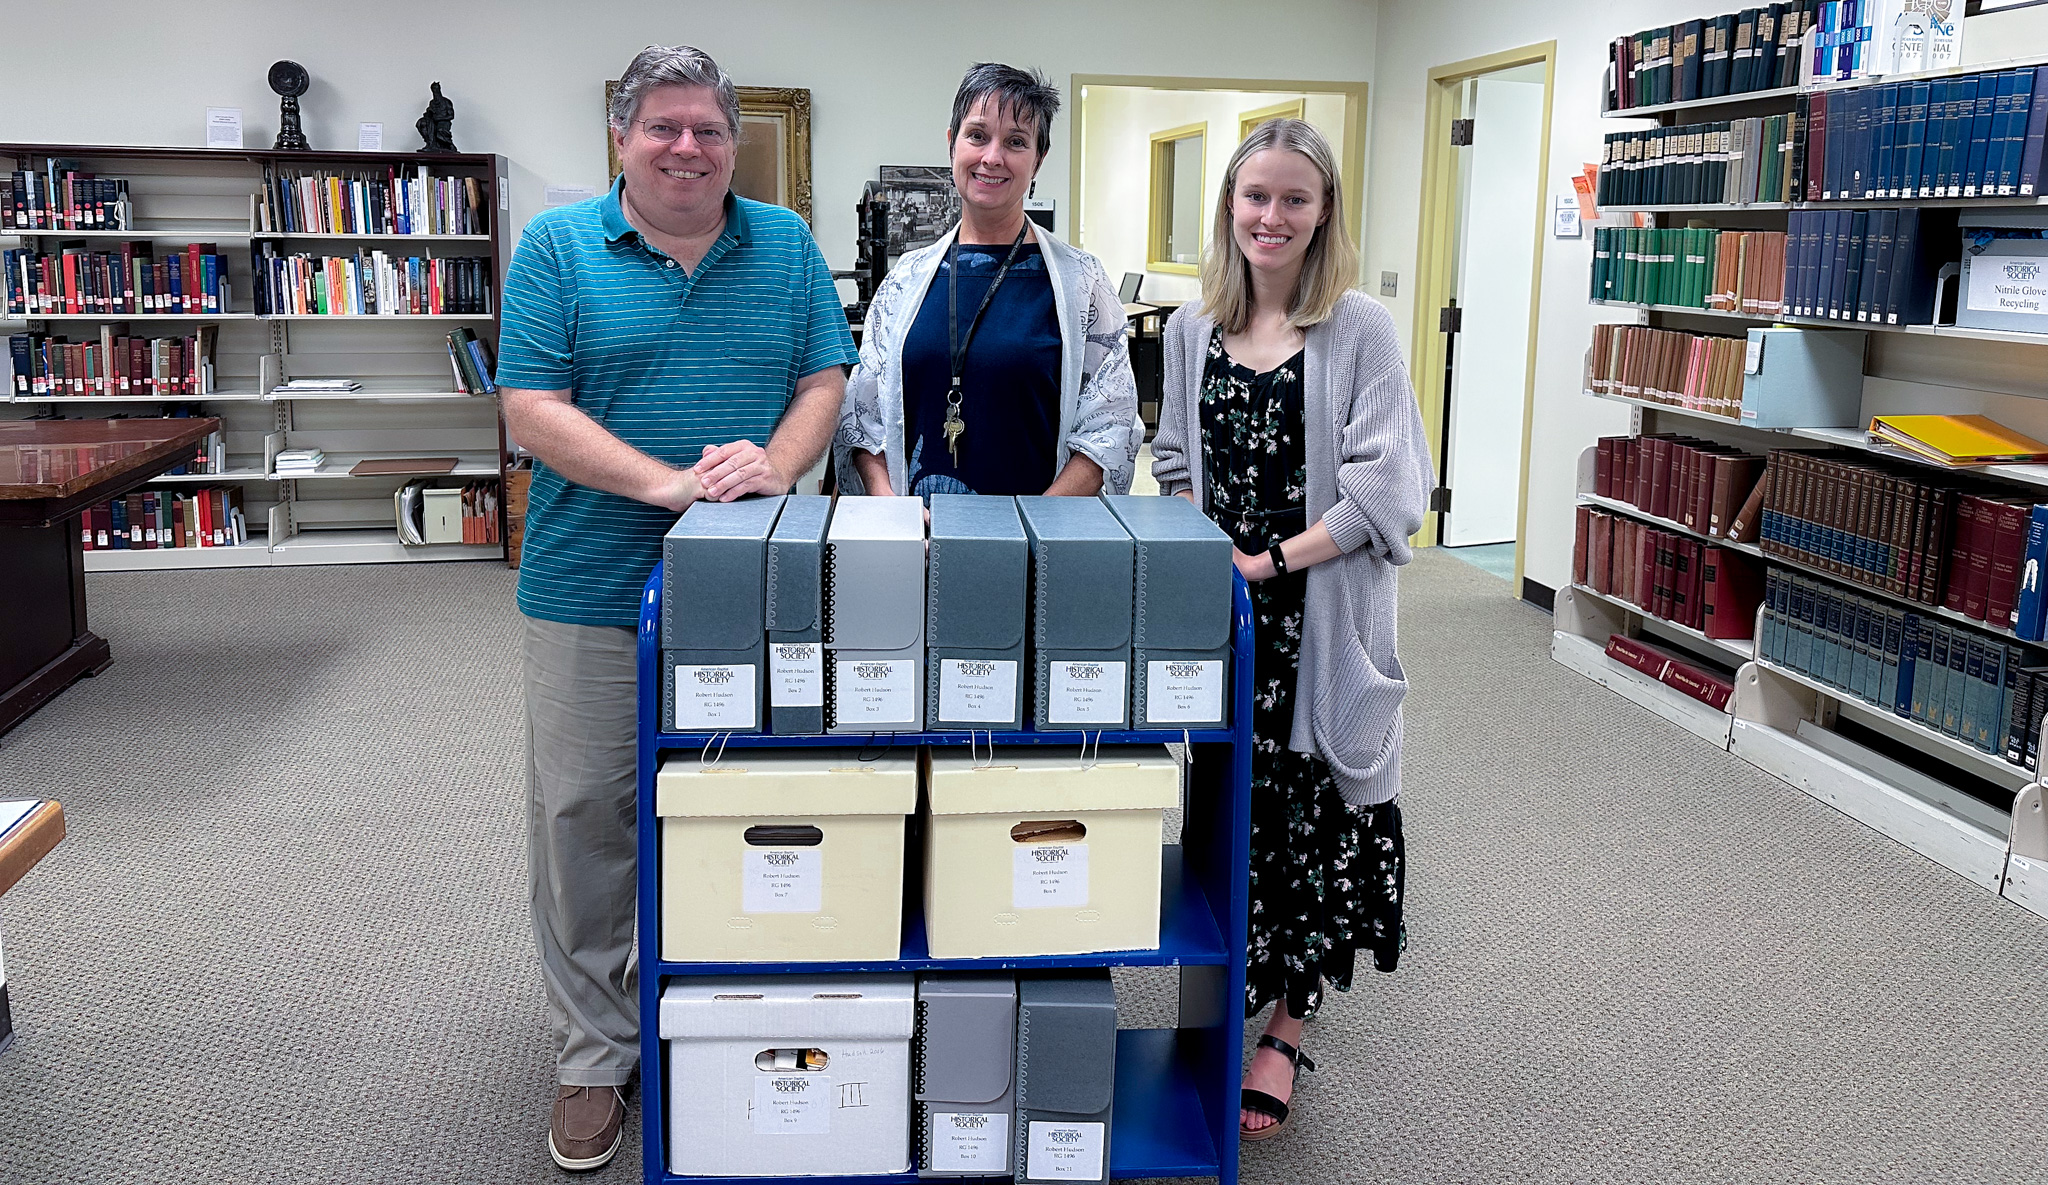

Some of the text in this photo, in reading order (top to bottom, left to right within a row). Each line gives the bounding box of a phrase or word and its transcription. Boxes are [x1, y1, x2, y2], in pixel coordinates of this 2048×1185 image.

[2002, 265, 2041, 273] HISTORICAL
[1994, 285, 2047, 296] Nitrile Glove
[2000, 298, 2040, 311] Recycling
[957, 662, 996, 670] HISTORICAL
[1031, 849, 1069, 857] HISTORICAL
[836, 1082, 869, 1109] III
